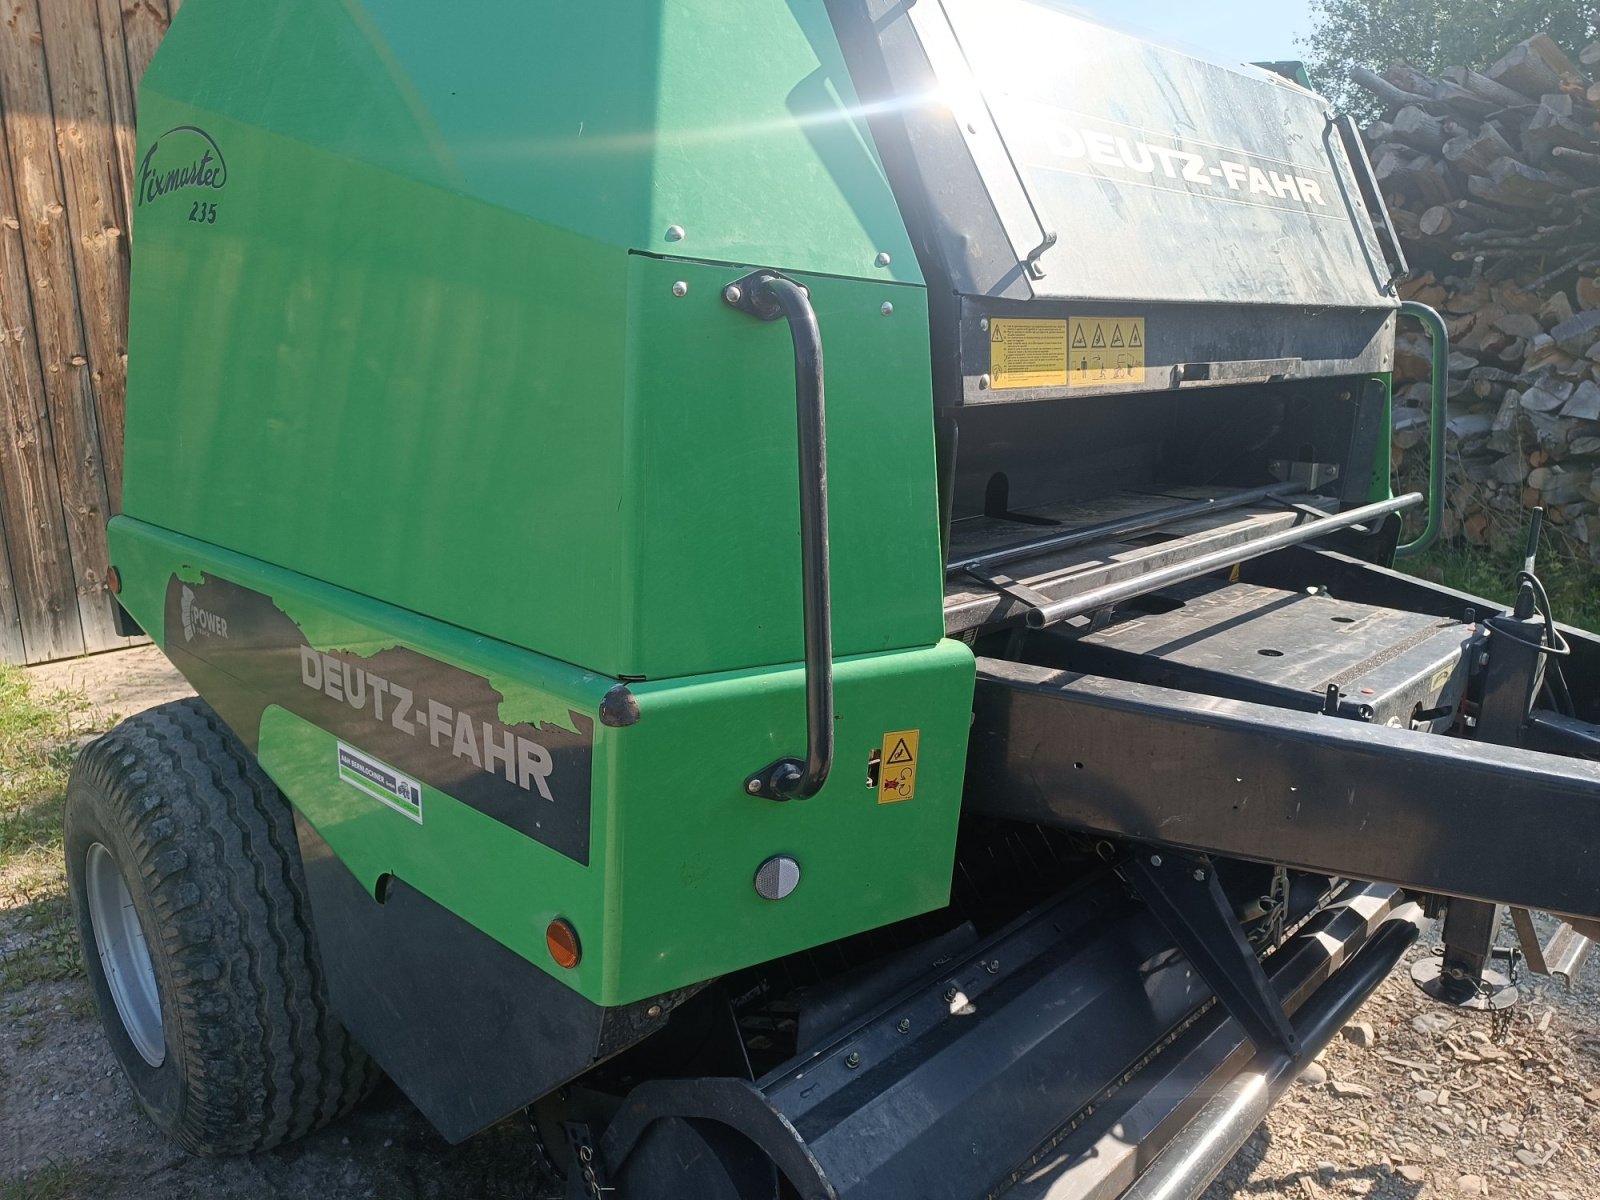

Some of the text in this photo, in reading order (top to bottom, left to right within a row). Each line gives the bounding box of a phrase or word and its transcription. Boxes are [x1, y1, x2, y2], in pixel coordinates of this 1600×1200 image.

[138, 126, 227, 207] Fixmaster
[1047, 124, 1326, 205] DEUTZ-FAHR
[188, 200, 218, 224] 235
[193, 606, 228, 639] POWER
[300, 643, 554, 802] DEUTZ-FAHR
